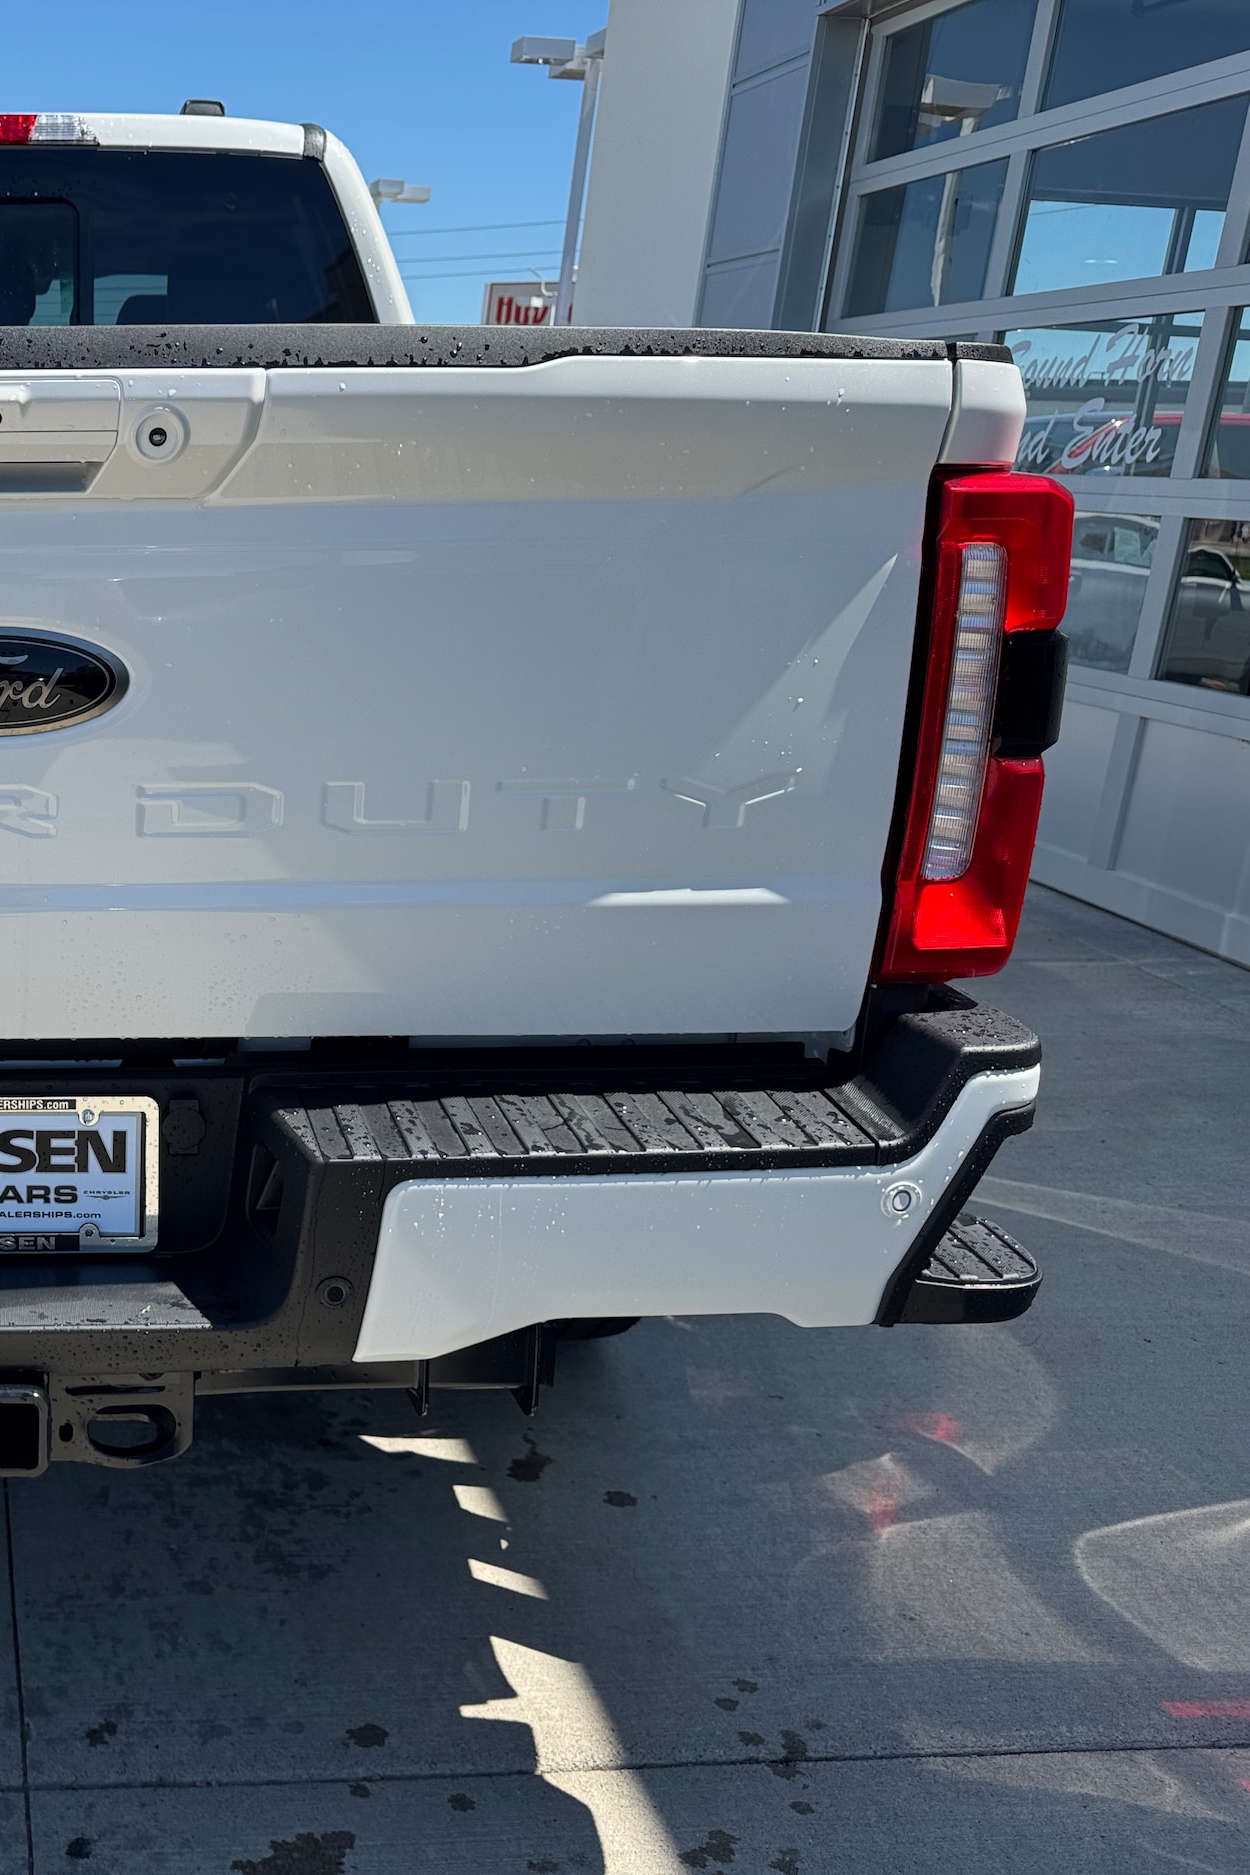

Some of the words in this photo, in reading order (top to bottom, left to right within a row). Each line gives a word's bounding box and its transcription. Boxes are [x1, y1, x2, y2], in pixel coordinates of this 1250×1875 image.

[1106, 323, 1194, 386] Horn
[1016, 411, 1058, 464] nd
[1062, 398, 1163, 469] Enter
[136, 775, 796, 837] DUTY
